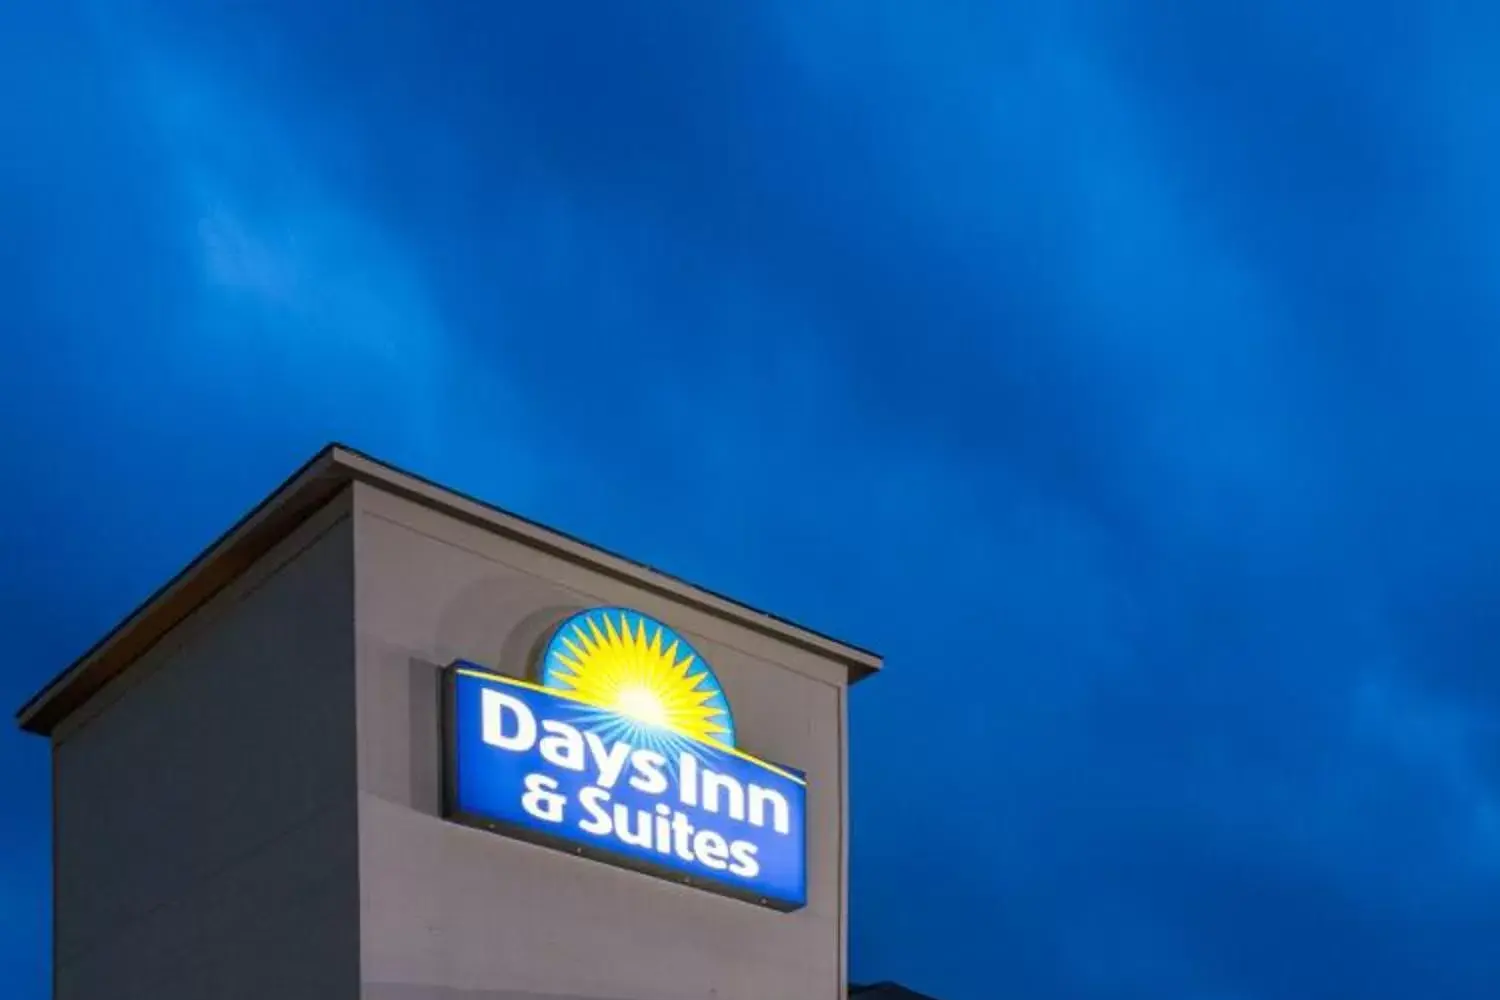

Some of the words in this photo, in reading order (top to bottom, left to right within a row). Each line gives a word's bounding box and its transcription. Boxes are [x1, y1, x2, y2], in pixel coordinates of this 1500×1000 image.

[480, 687, 668, 795] Days
[679, 752, 790, 835] Inn
[521, 773, 567, 823] &
[578, 786, 760, 878] Suites
